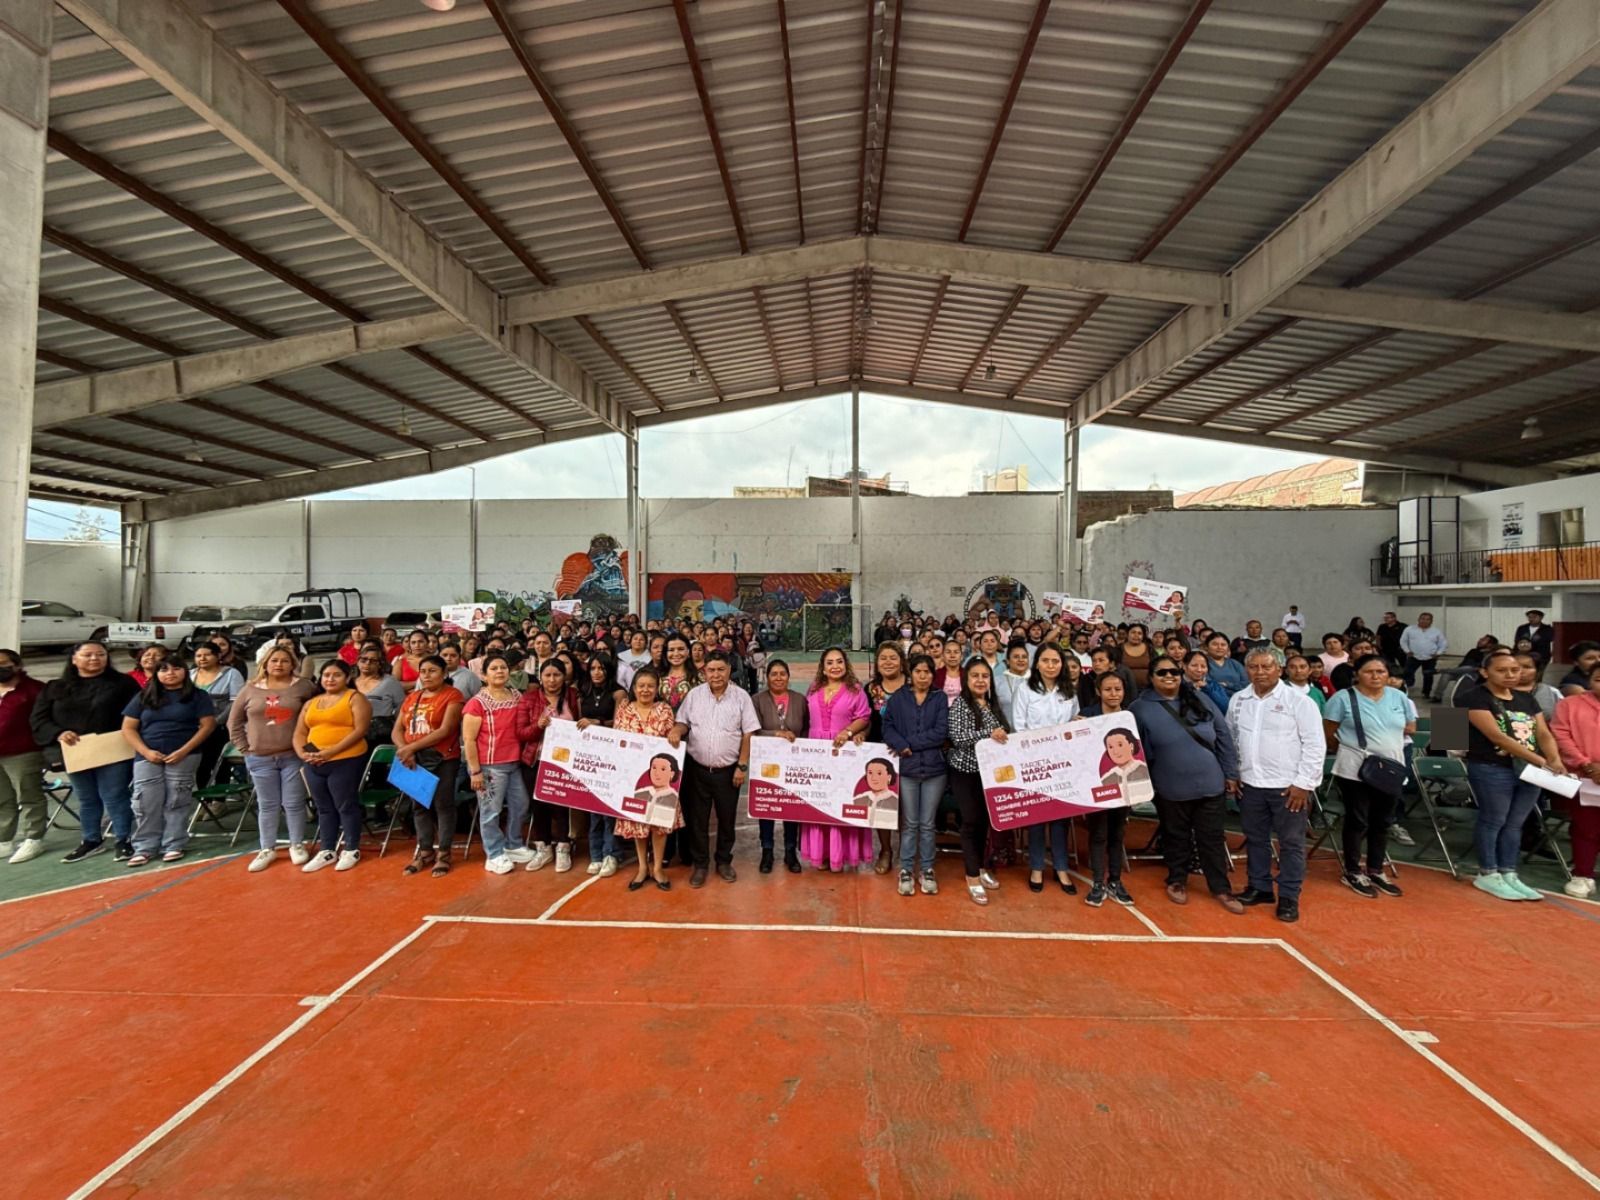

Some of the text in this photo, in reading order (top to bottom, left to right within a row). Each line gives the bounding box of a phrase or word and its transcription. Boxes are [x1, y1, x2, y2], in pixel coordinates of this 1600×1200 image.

[592, 735, 615, 744] OAXACA
[1032, 736, 1058, 745] OAXACA
[575, 751, 602, 761] TARJETA
[574, 758, 616, 771] MARGARITA
[1020, 759, 1051, 769] TARJETA
[1021, 761, 1072, 776] MARGARITA
[573, 764, 597, 774] MAZA
[544, 770, 560, 779] 1234
[785, 772, 832, 780] MARGARITA
[1022, 772, 1052, 783] MAZA
[543, 778, 564, 787] NOMBRE
[1096, 789, 1117, 797] BANCO
[993, 793, 1012, 803] 1234
[996, 802, 1021, 811] NOMBRE
